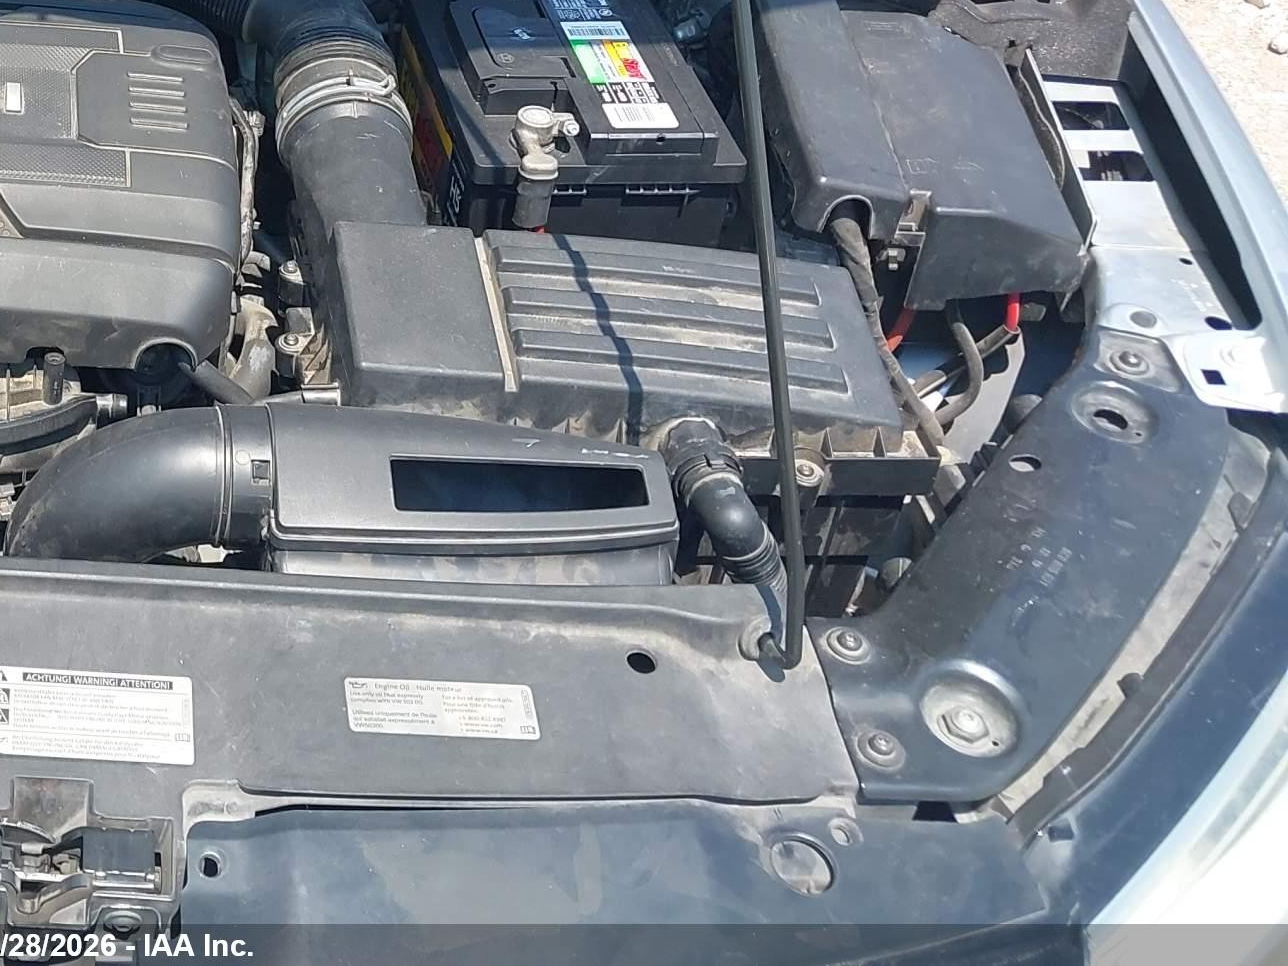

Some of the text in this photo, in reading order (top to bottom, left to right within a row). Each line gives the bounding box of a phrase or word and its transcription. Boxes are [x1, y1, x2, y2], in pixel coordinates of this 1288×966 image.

[25, 673, 170, 689] ACHTUNG! WARNING! ATTENTION!
